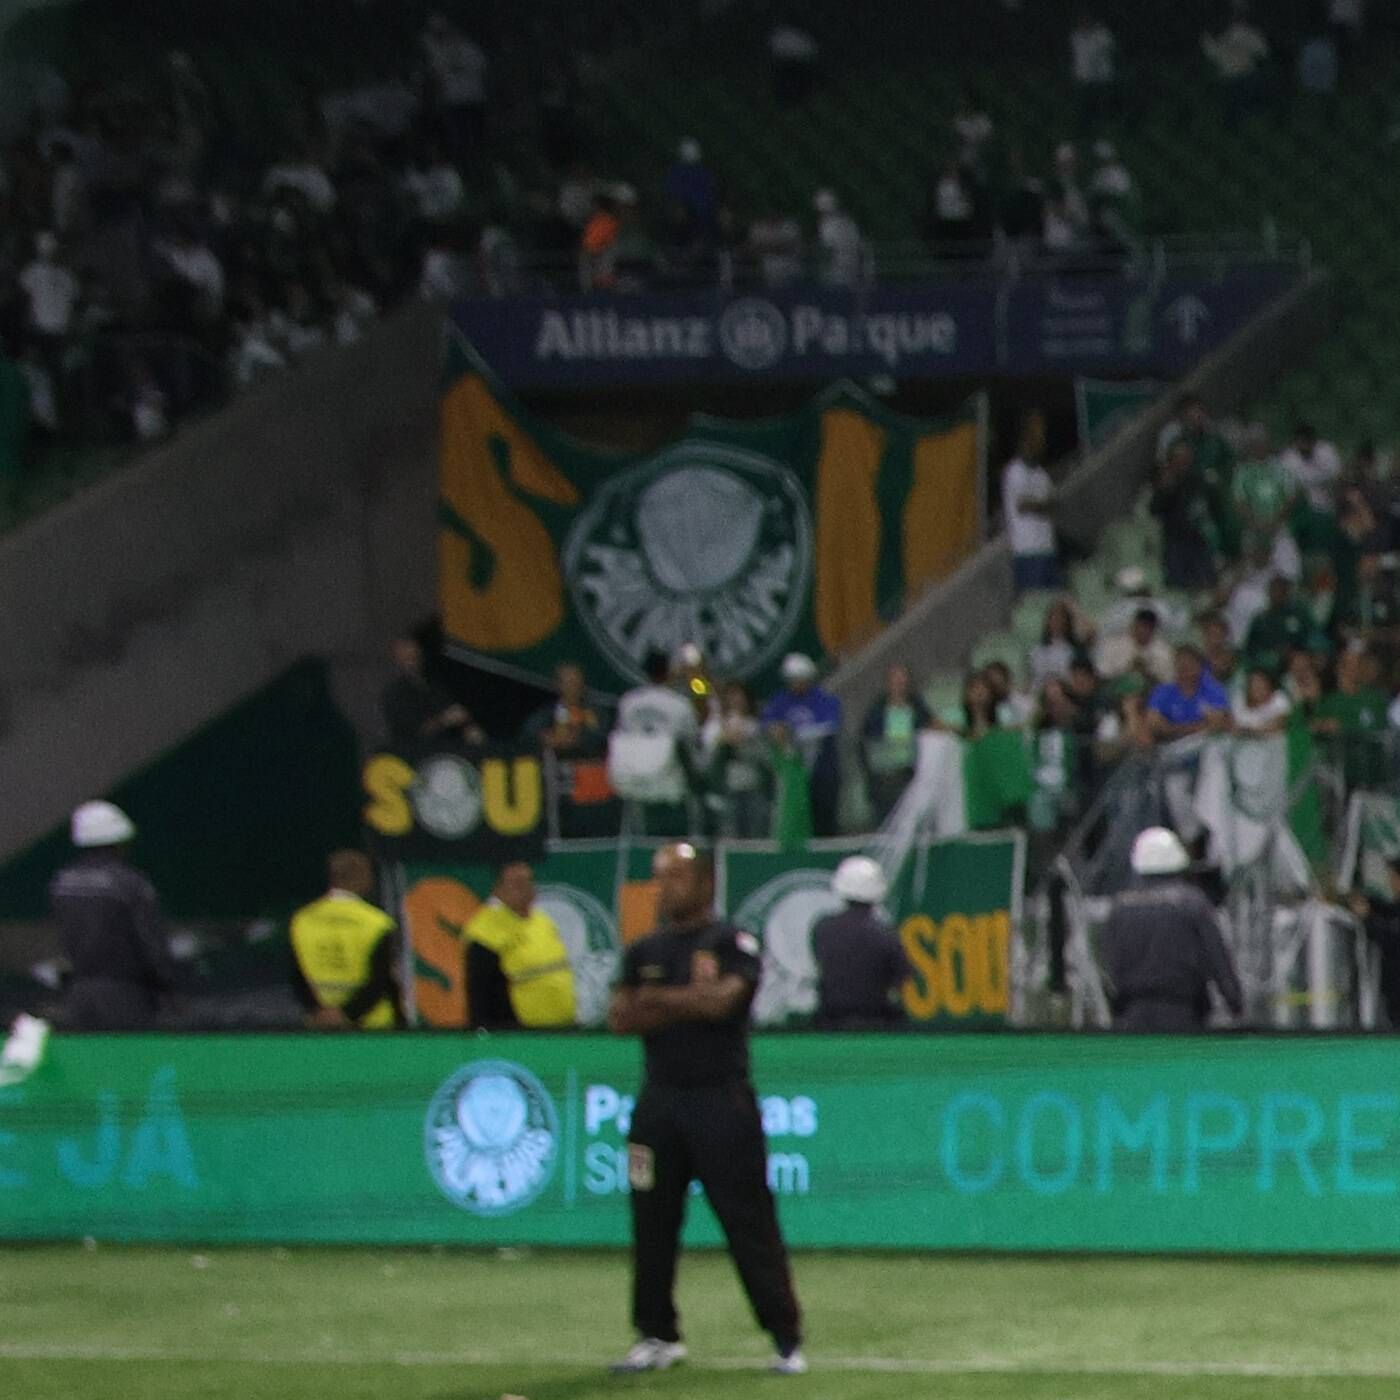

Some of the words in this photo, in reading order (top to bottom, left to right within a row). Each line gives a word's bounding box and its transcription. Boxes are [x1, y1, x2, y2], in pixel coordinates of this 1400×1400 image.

[536, 309, 711, 359] Allianz
[792, 305, 957, 366] Paque
[939, 1092, 1400, 1196] COMPRE
